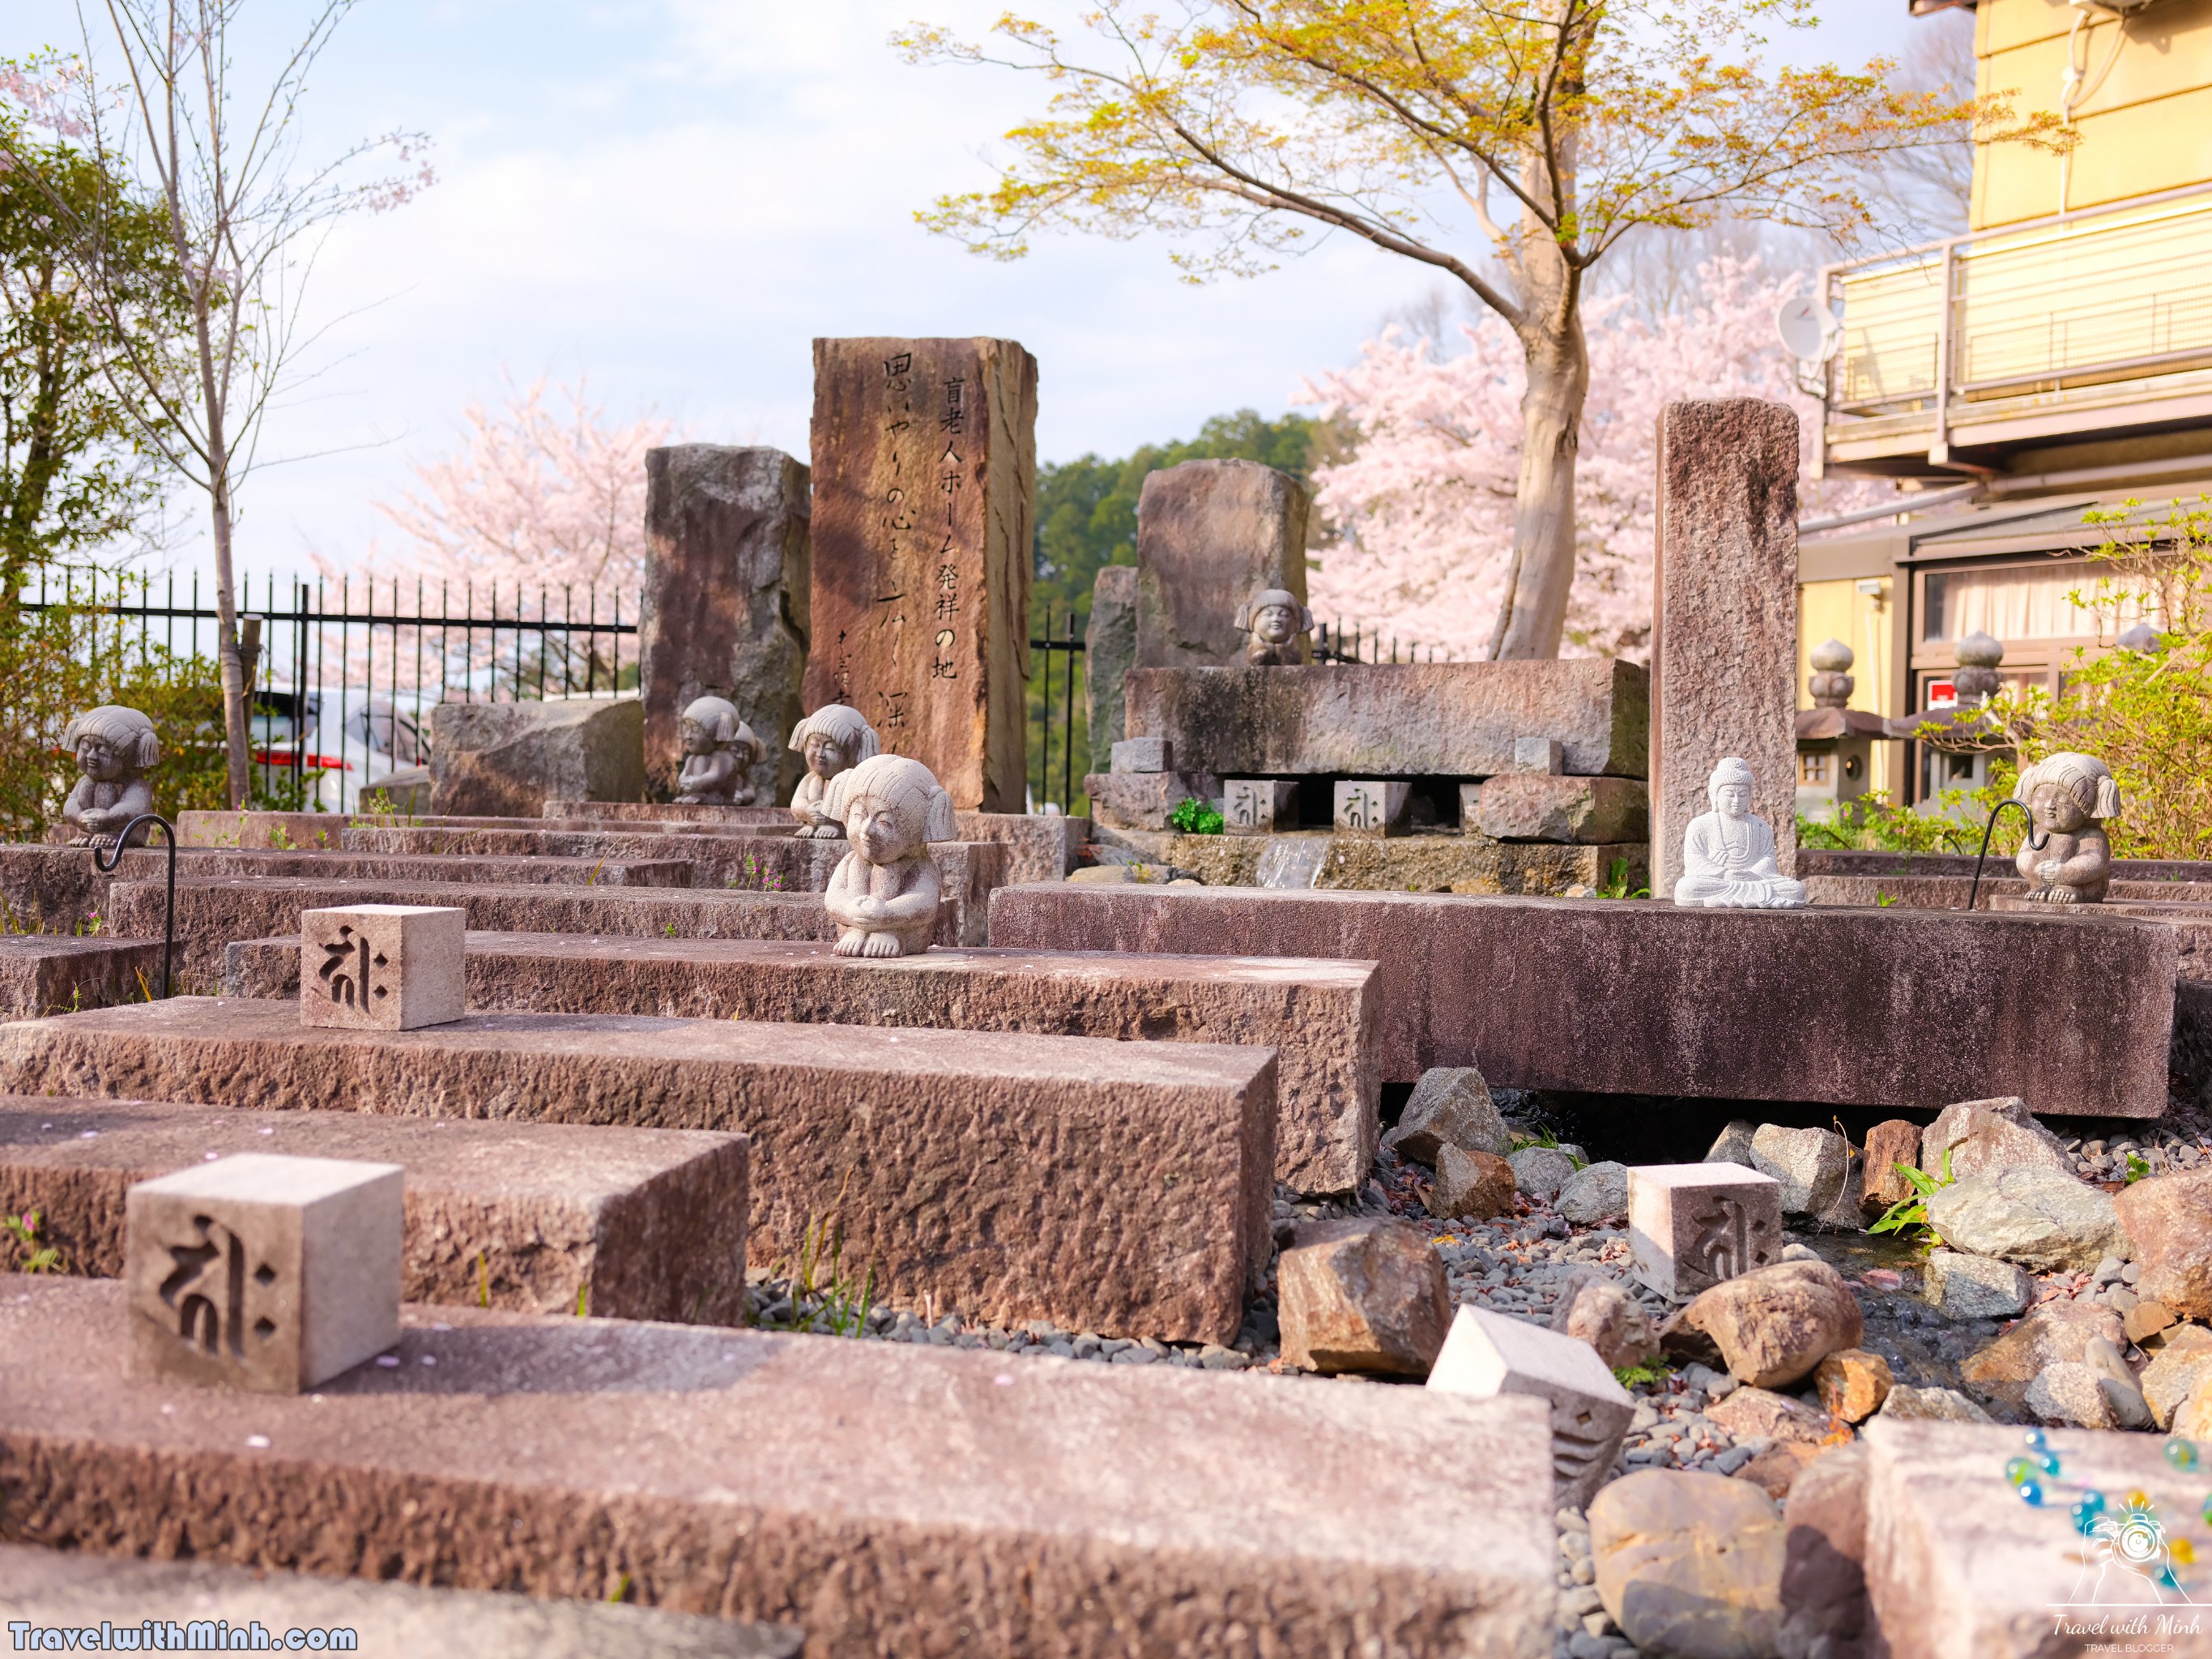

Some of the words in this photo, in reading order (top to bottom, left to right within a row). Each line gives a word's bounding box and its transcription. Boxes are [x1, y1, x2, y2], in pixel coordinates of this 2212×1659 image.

[931, 376, 965, 679] 盲老人ホーム発祥の地
